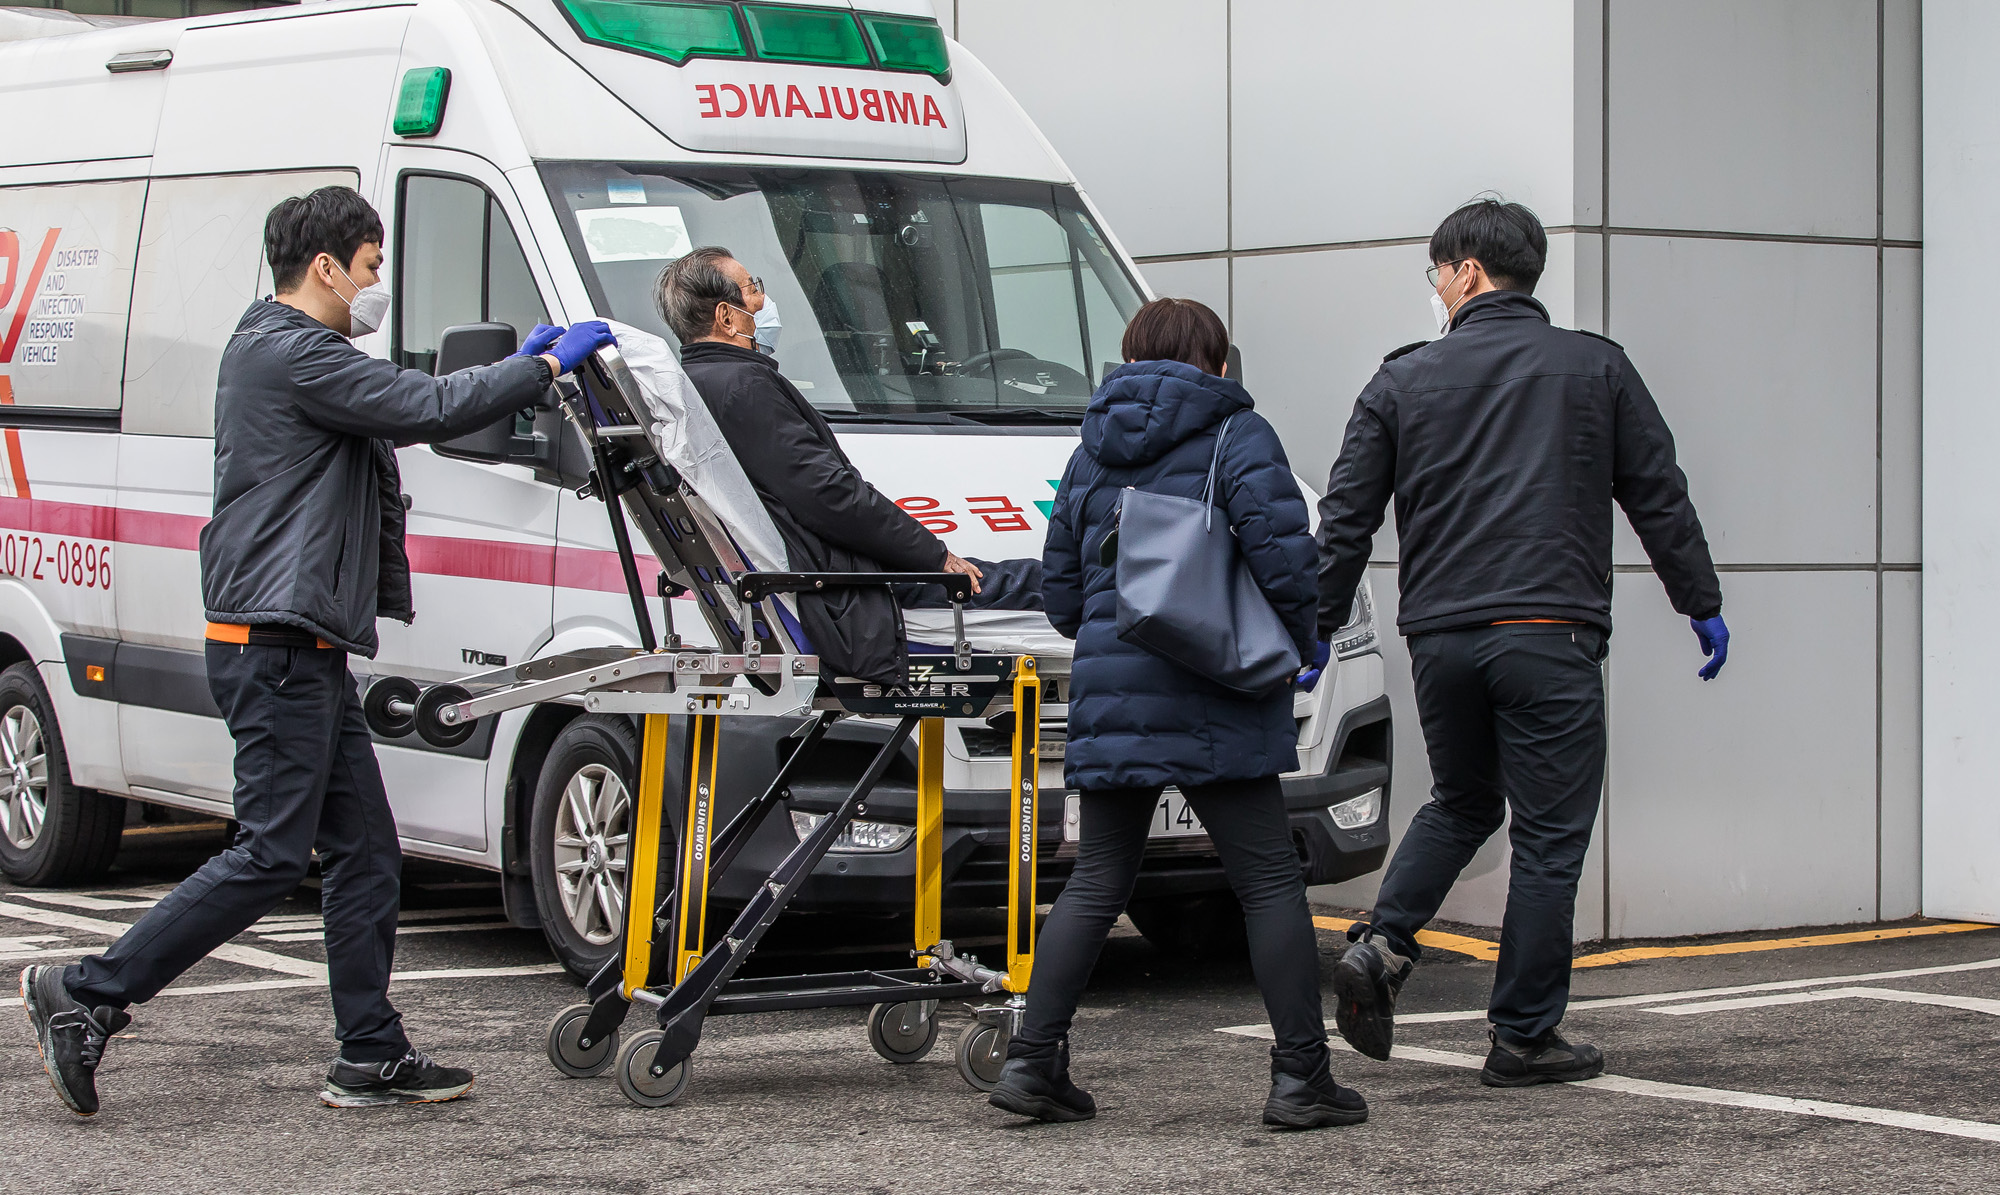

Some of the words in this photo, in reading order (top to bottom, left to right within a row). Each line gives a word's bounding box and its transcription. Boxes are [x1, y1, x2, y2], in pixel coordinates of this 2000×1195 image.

[57, 249, 98, 267] DISASTER
[45, 275, 65, 291] AND
[38, 298, 84, 315] INFECTION
[29, 322, 74, 339] RESPONSE
[22, 346, 57, 362] VEHICLE
[0, 534, 111, 590] 072-0896
[863, 684, 970, 697] SAVER
[1159, 799, 1203, 830] 14
[695, 800, 707, 861] SUNGWOO
[1021, 797, 1032, 862] SUNGWOO
